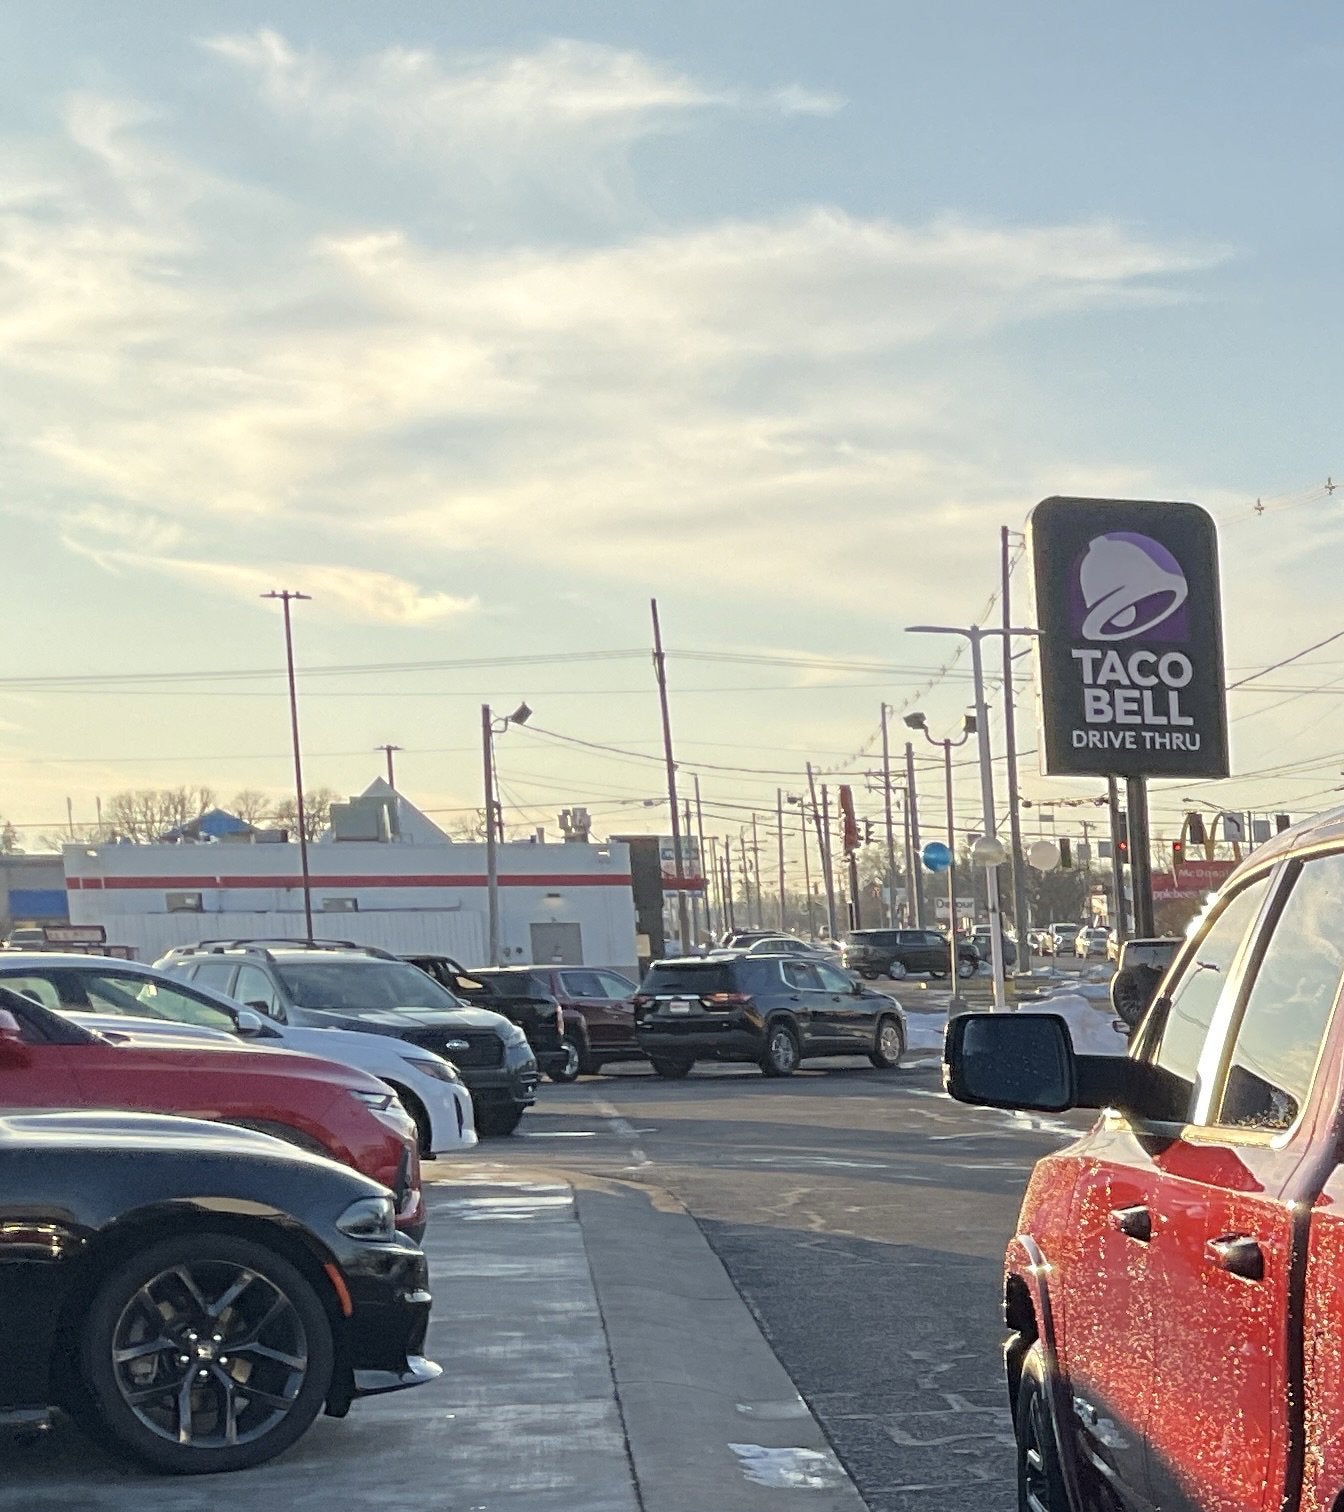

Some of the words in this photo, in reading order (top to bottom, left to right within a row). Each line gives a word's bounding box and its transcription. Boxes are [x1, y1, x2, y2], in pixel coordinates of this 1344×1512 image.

[1071, 648, 1193, 688] TACO
[1083, 688, 1194, 726] BELL
[1072, 730, 1137, 749] DRIVE
[1141, 731, 1200, 751] THRU
